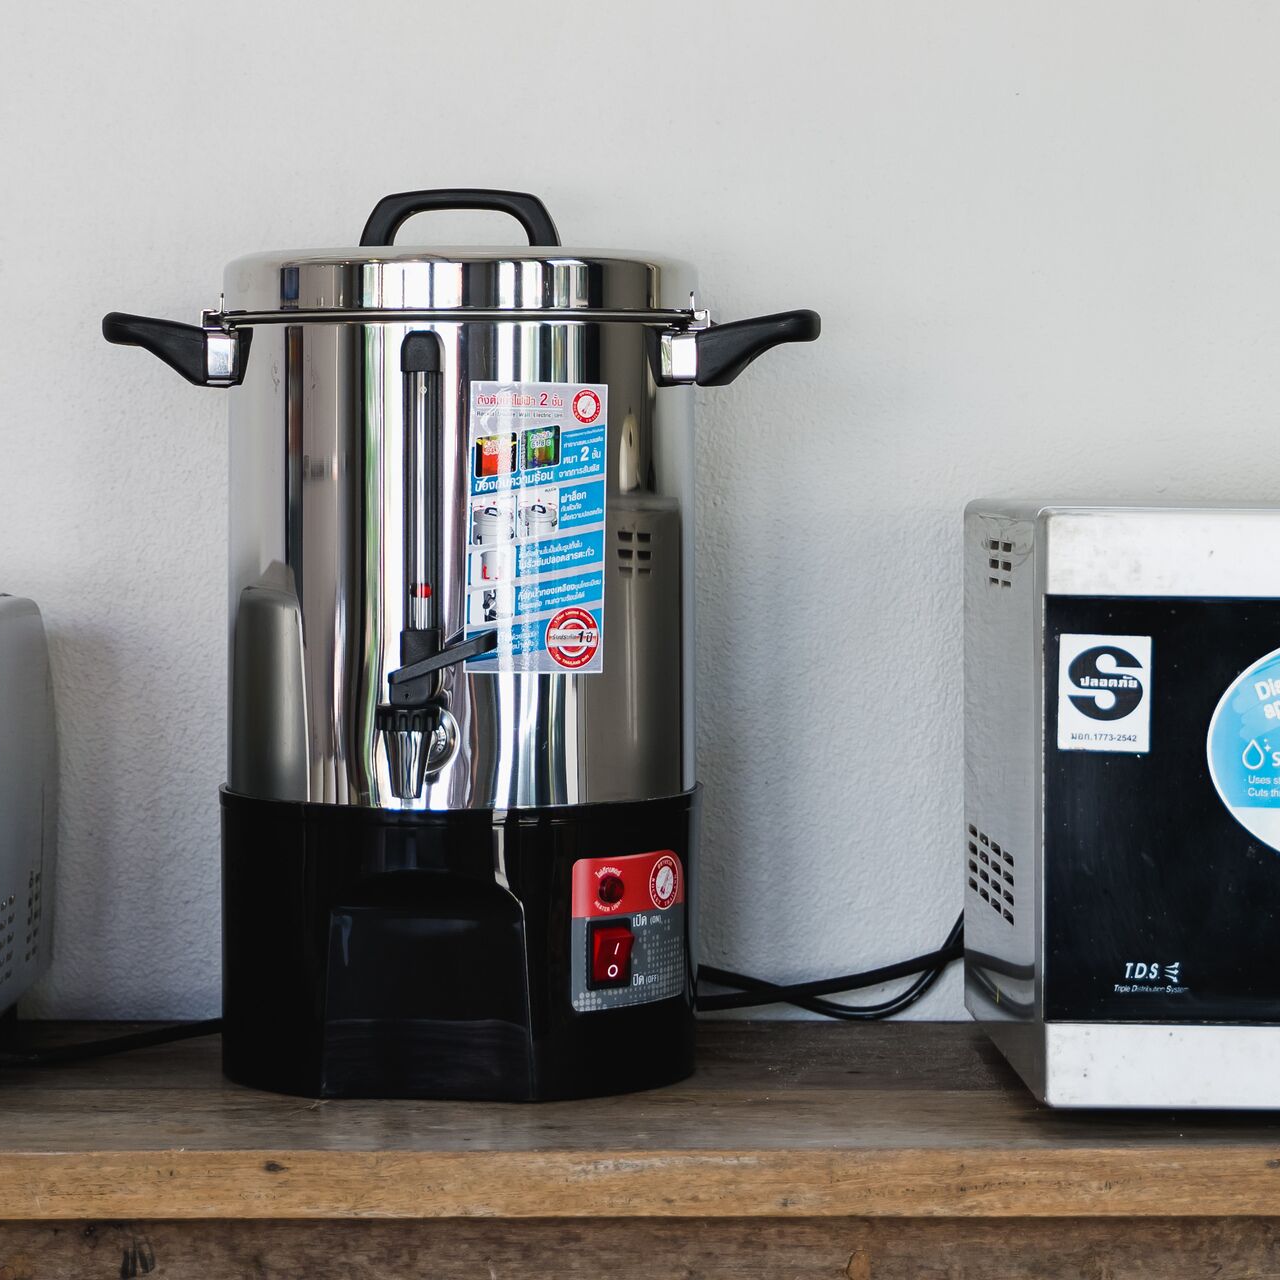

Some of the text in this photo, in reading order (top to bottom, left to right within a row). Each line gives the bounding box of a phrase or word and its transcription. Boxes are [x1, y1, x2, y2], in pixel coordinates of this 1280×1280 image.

[539, 392, 548, 407] 2
[580, 445, 590, 463] 2
[1080, 675, 1138, 689] ปลอดภัย
[1070, 732, 1138, 743] มอก.1773-2542
[1248, 775, 1271, 785] Uses
[1247, 788, 1268, 797] Cuts
[632, 913, 648, 927] เปิด
[1125, 962, 1161, 979] T.D.S.
[632, 973, 645, 987] ปิด
